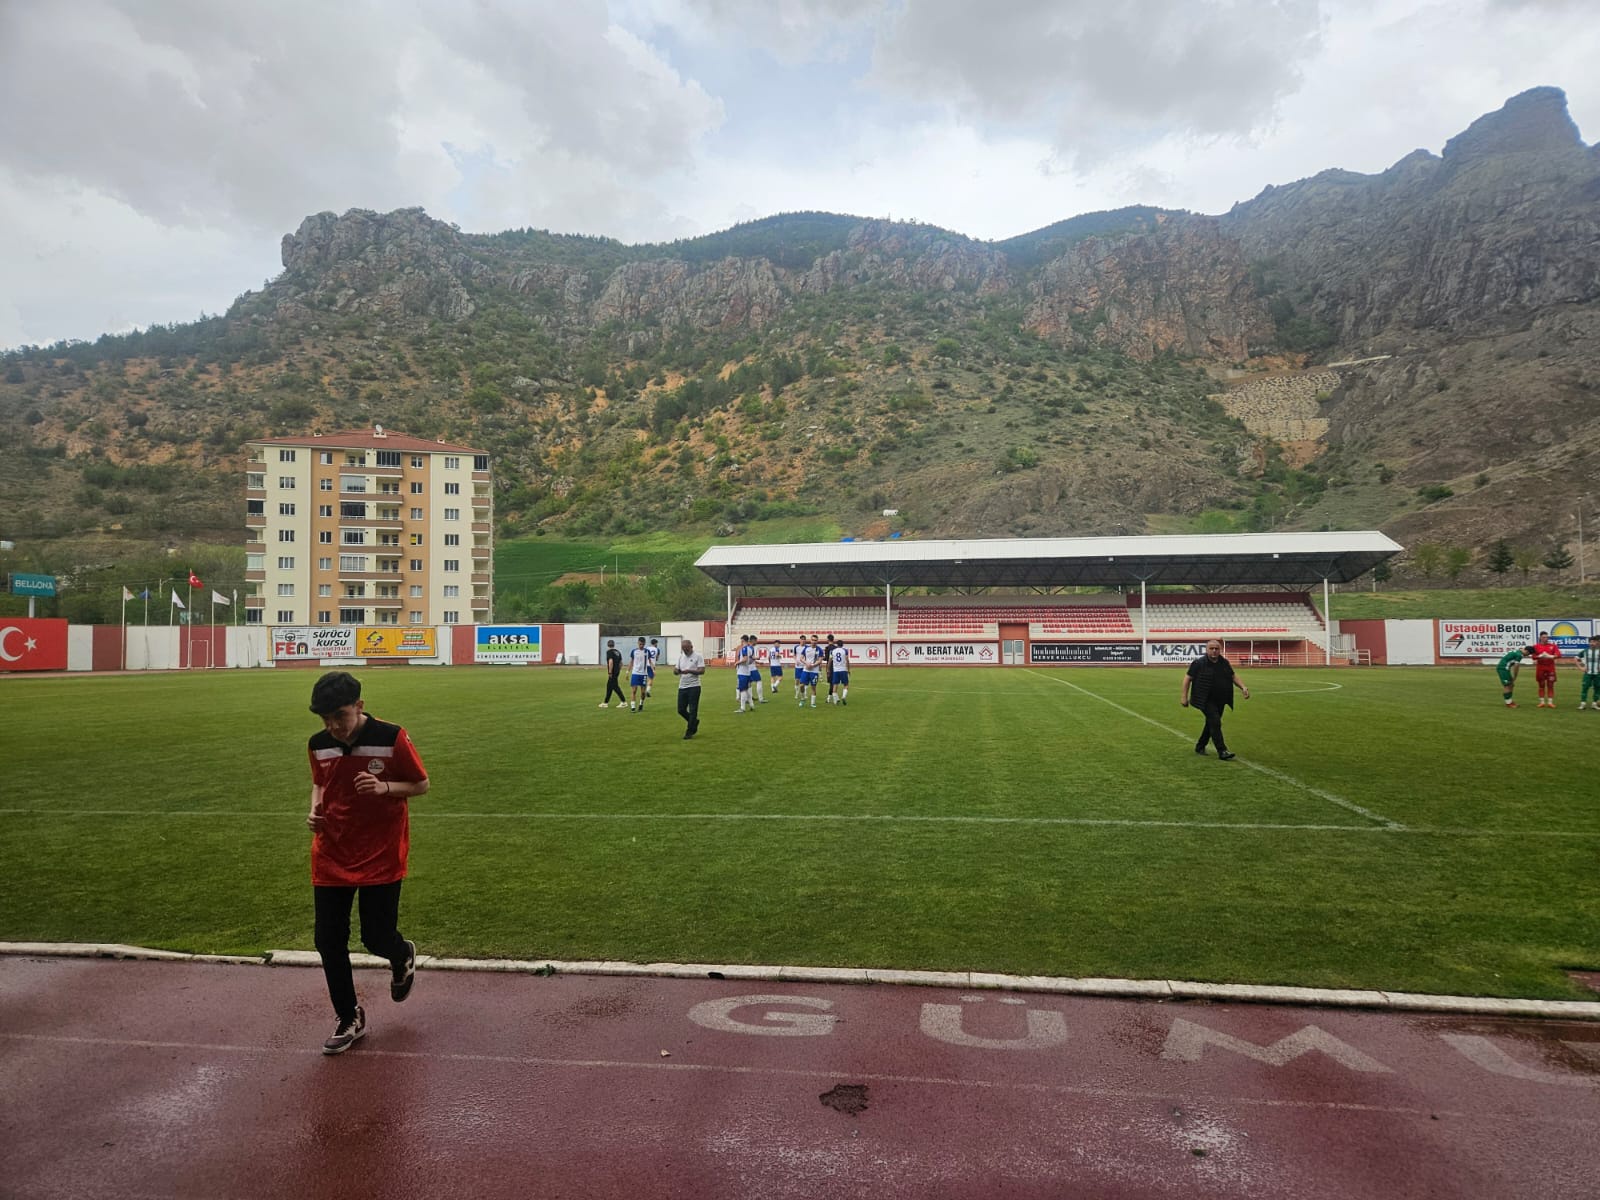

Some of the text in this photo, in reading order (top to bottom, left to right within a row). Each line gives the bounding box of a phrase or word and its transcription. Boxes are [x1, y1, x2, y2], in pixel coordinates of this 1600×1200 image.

[15, 579, 54, 590] BELLONA
[316, 639, 348, 647] kursu
[489, 634, 529, 645] aksa
[1564, 637, 1589, 645] Hotel
[926, 646, 952, 655] BERAT
[953, 646, 974, 655] KAYA
[836, 652, 842, 662] 8
